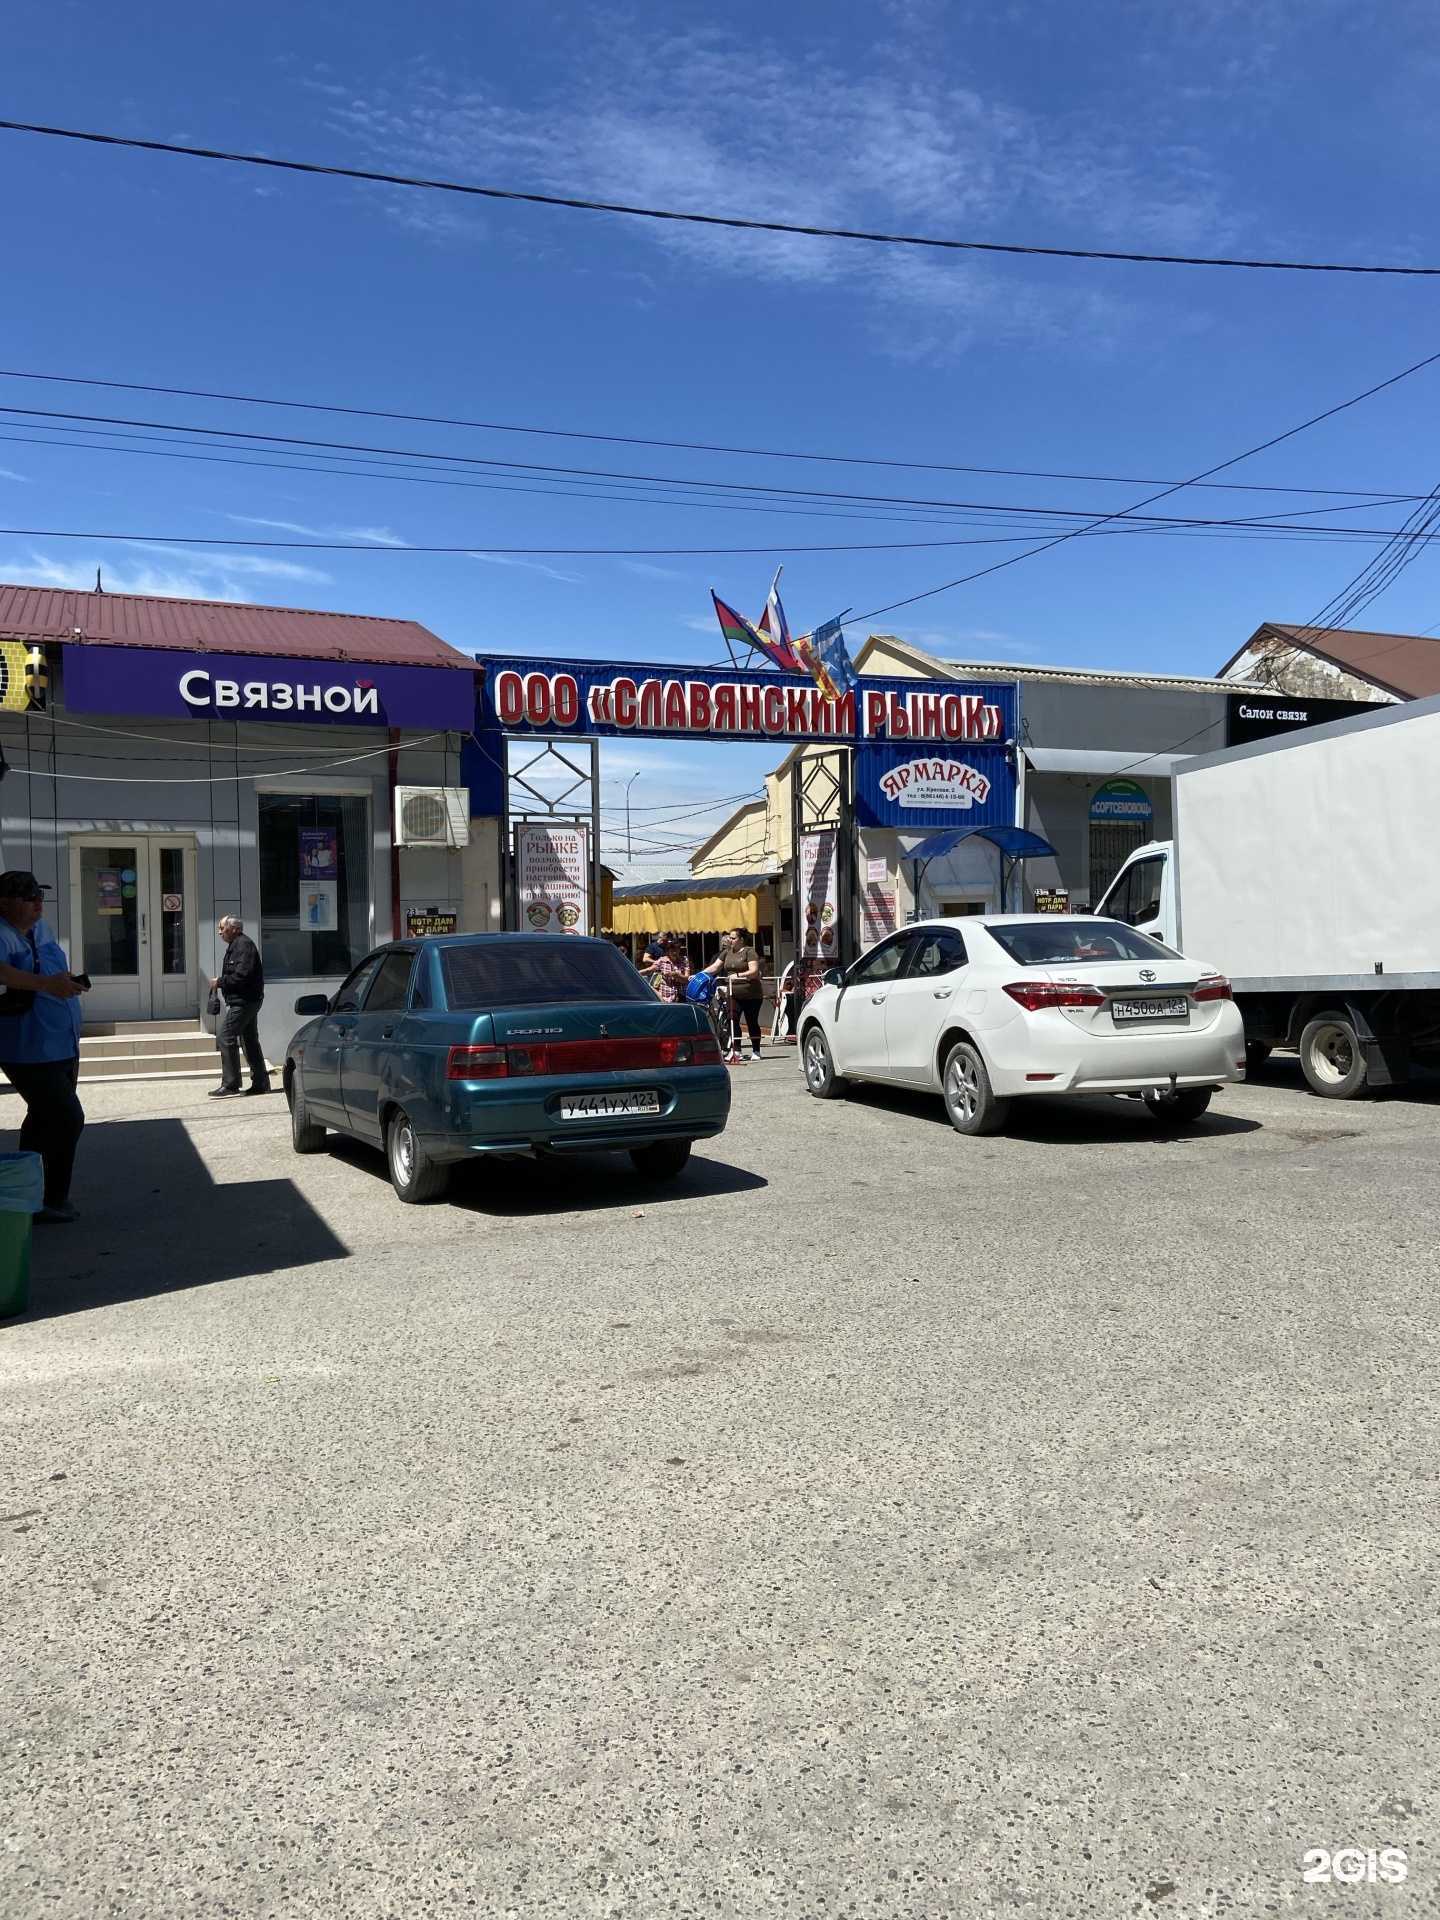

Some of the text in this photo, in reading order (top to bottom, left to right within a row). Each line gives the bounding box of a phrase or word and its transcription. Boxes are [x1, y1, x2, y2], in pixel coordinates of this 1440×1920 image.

[495, 671, 578, 727] ООО
[863, 690, 1001, 742] РЫНОК»
[1239, 705, 1307, 721] Салон связи
[883, 762, 987, 799] ЯРМАРКА
[530, 833, 562, 841] Только
[527, 842, 579, 854] РЫНКЕ
[526, 864, 580, 873] приобрести
[1117, 1001, 1164, 1016] Н450ОА
[567, 1093, 656, 1116] У441УХ 123
